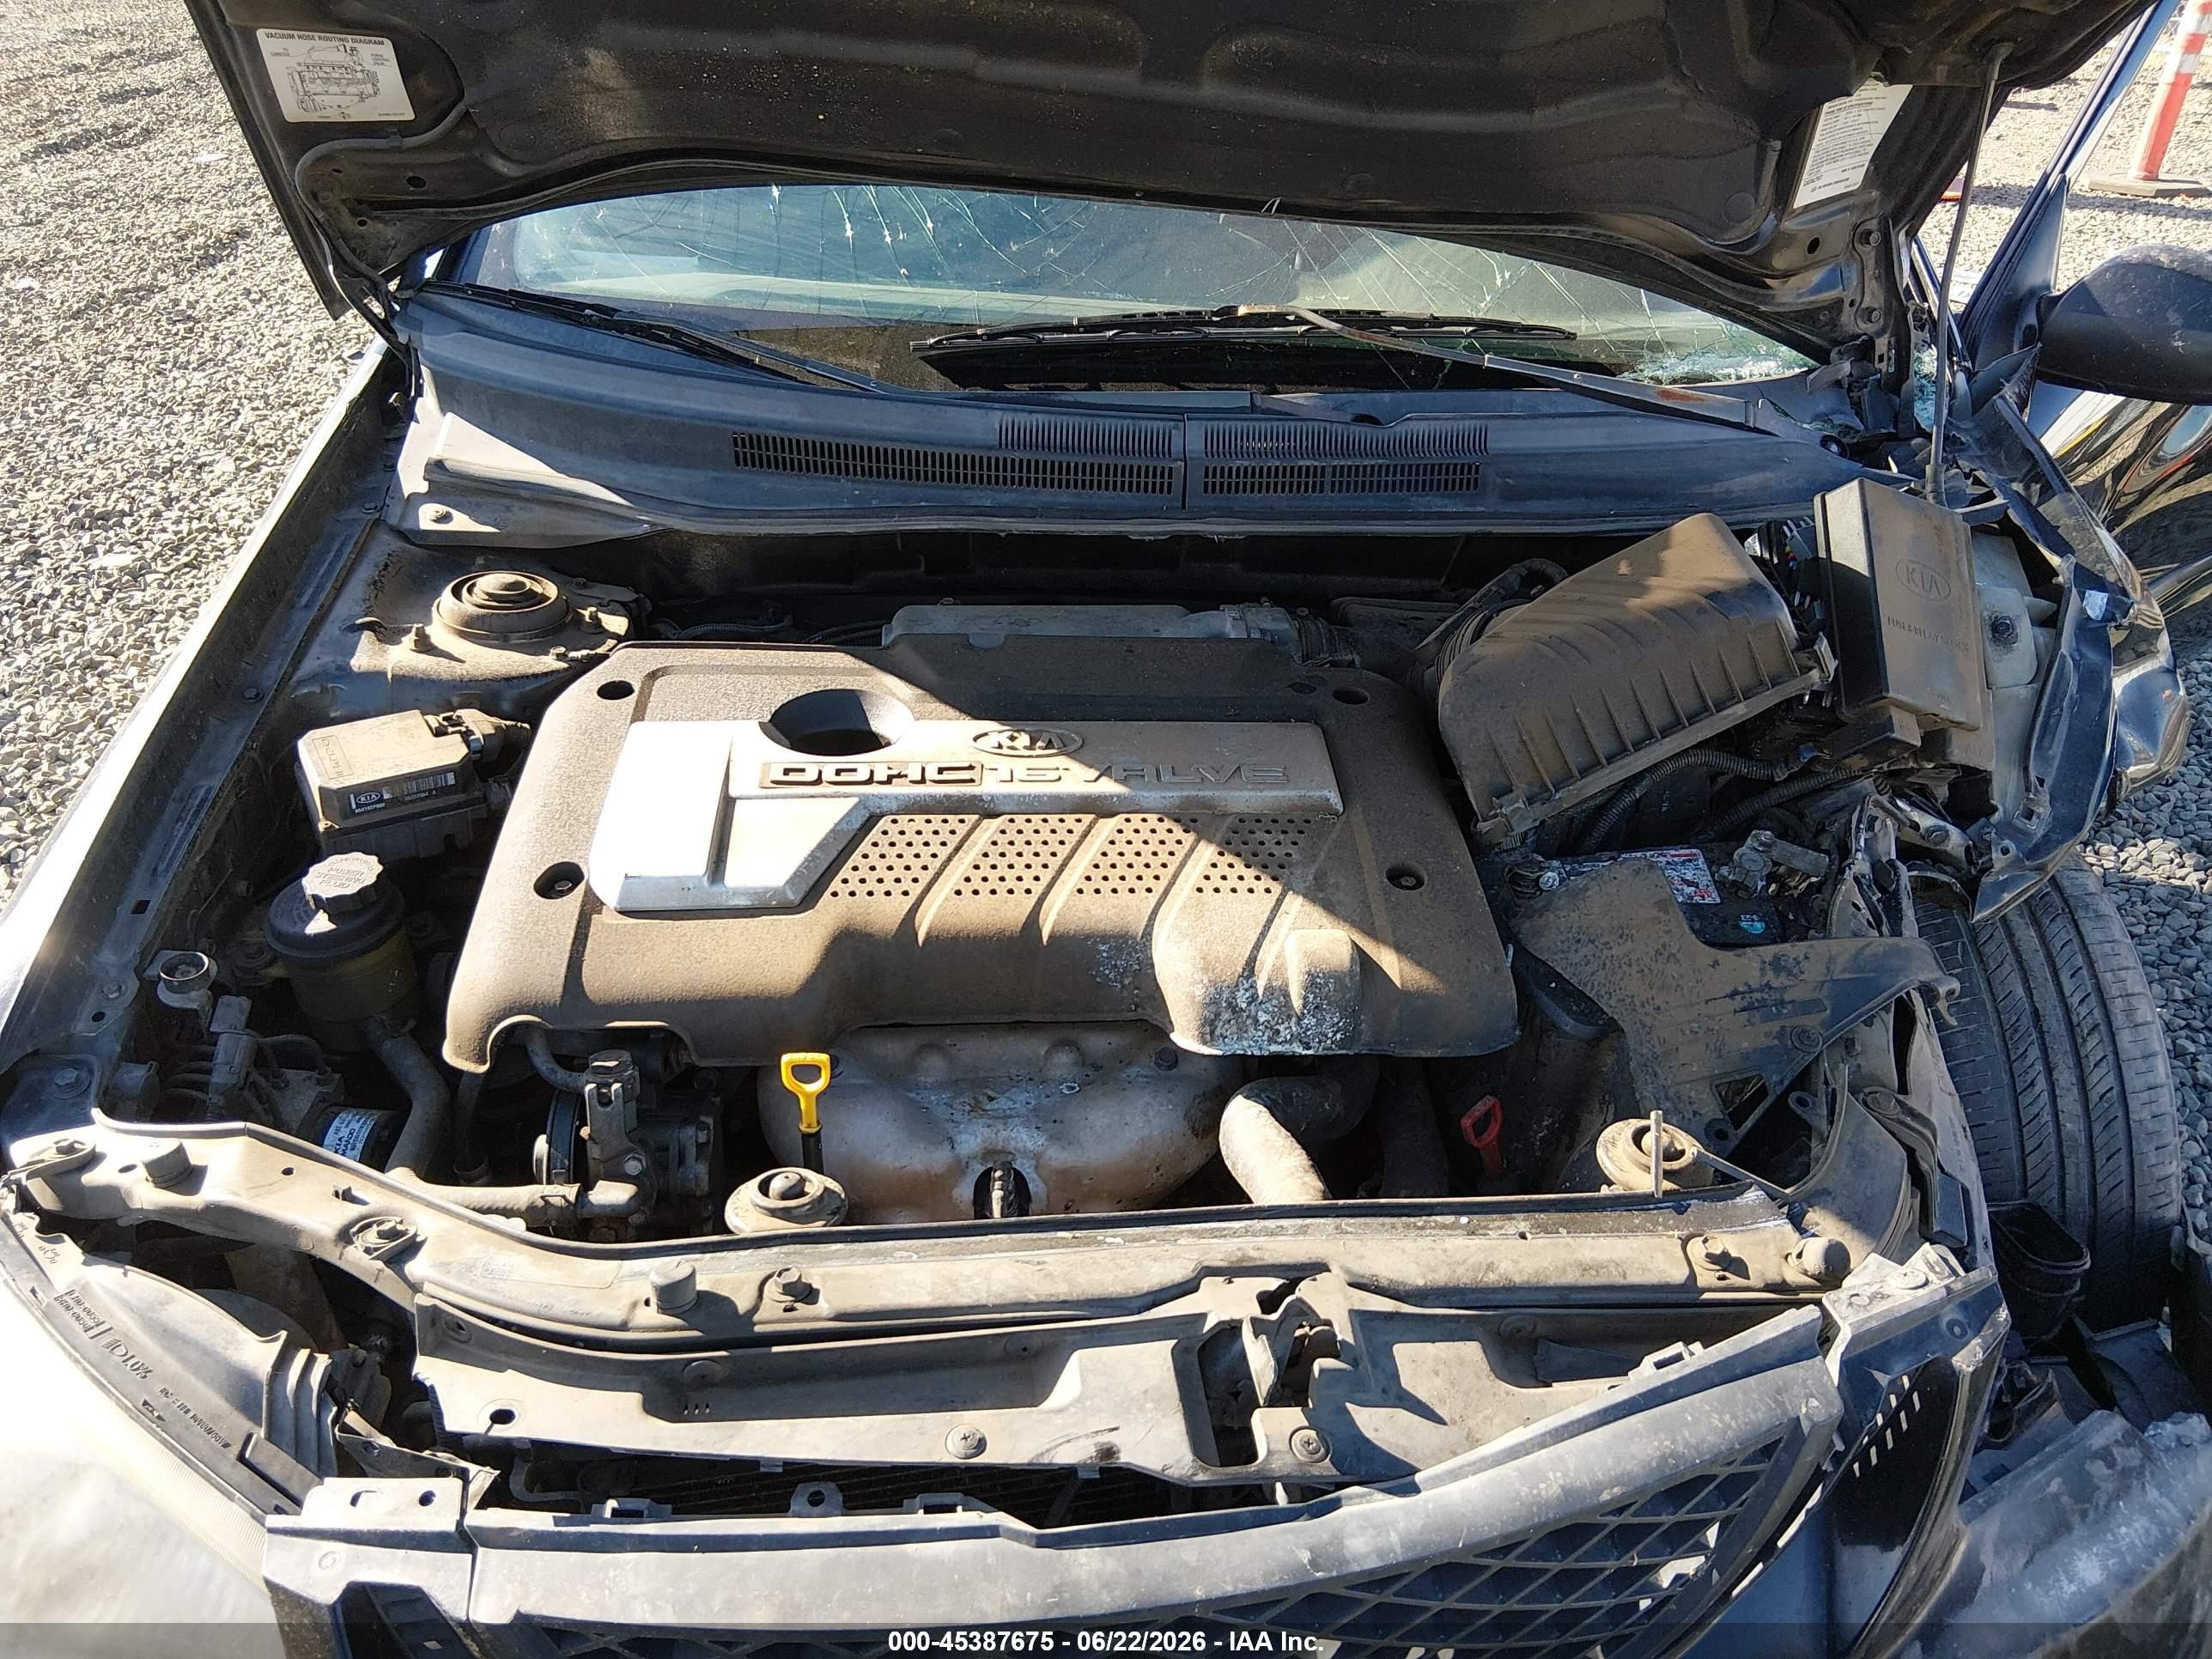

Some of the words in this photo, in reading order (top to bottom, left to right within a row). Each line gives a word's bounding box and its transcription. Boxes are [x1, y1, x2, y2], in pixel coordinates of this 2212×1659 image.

[350, 37, 385, 46] DIAGRAM
[1905, 562, 1941, 598] KIA
[990, 729, 1066, 750] KIA
[321, 738, 344, 776] DELPHI
[769, 762, 977, 785] DOHC
[1066, 763, 1290, 784] VALVE
[360, 793, 377, 802] KIA
[327, 866, 364, 877] POWER
[315, 872, 366, 884] STEERING
[319, 879, 349, 889] FLUID
